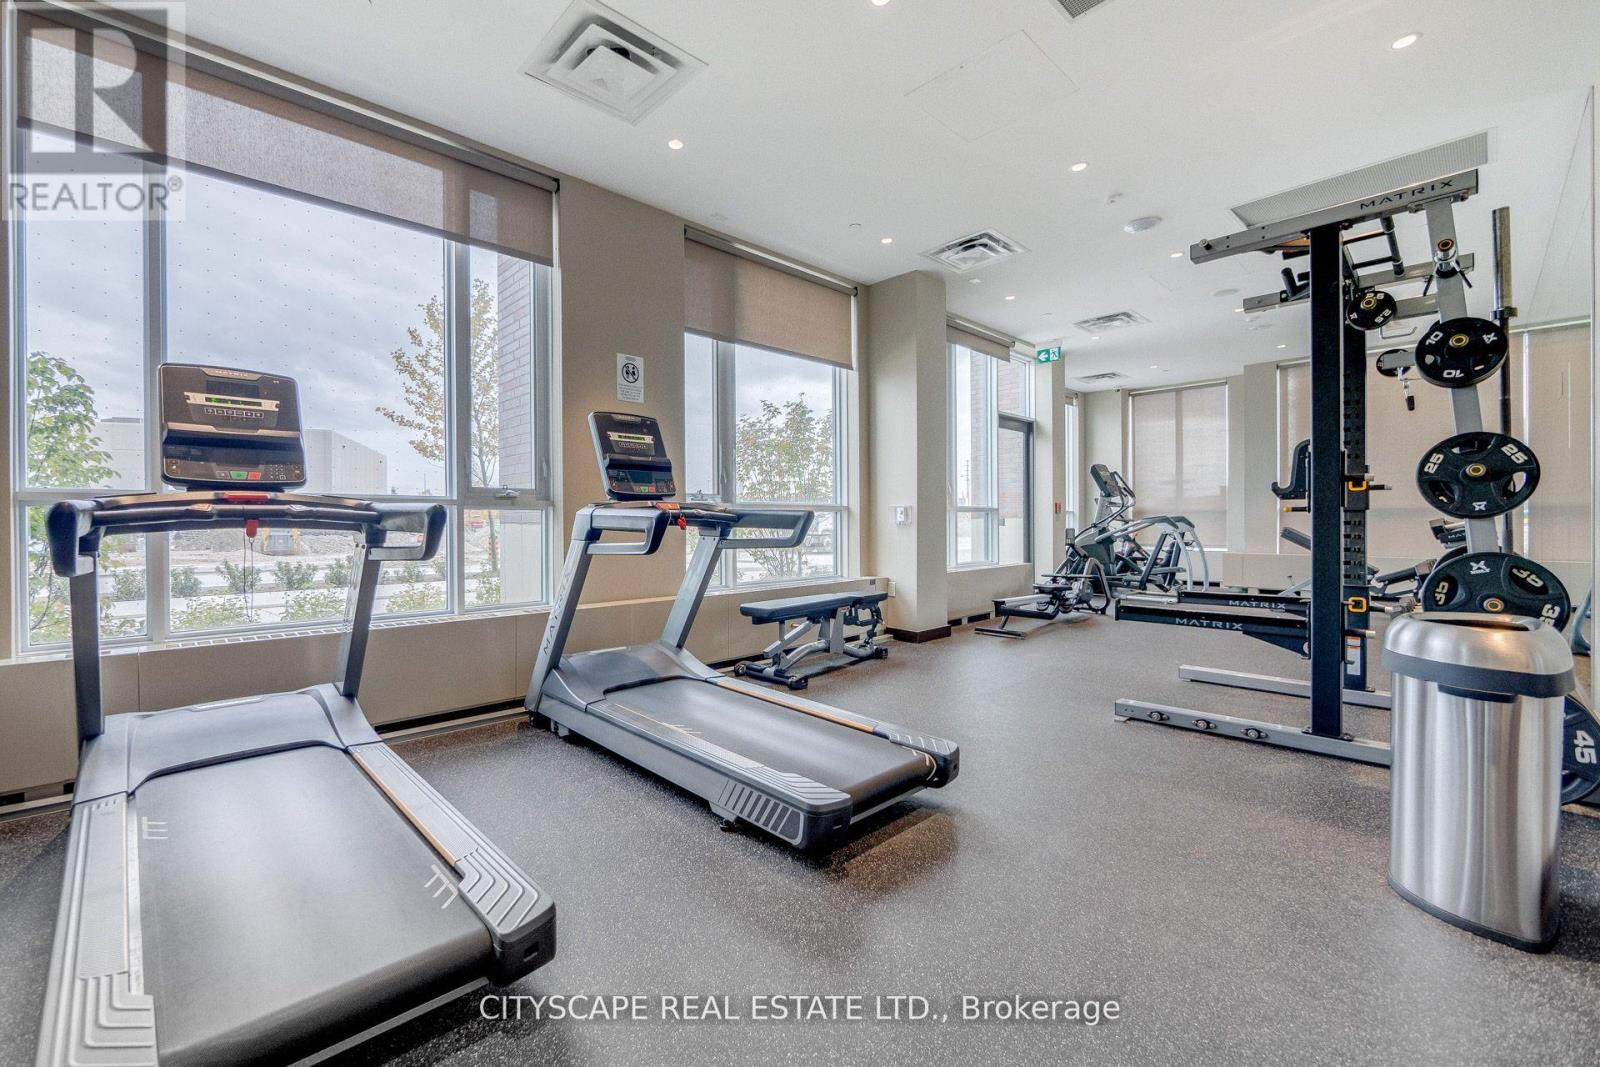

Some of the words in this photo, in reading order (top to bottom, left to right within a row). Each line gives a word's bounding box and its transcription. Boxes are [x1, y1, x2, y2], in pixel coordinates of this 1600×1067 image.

[1360, 180, 1452, 210] MATRIX
[1425, 331, 1443, 346] 10
[1443, 369, 1464, 378] 10
[1501, 443, 1528, 464] 25
[1424, 453, 1444, 474] 25
[1229, 600, 1286, 609] MATRIX
[1175, 618, 1243, 630] MATRIX
[1574, 730, 1597, 764] 45
